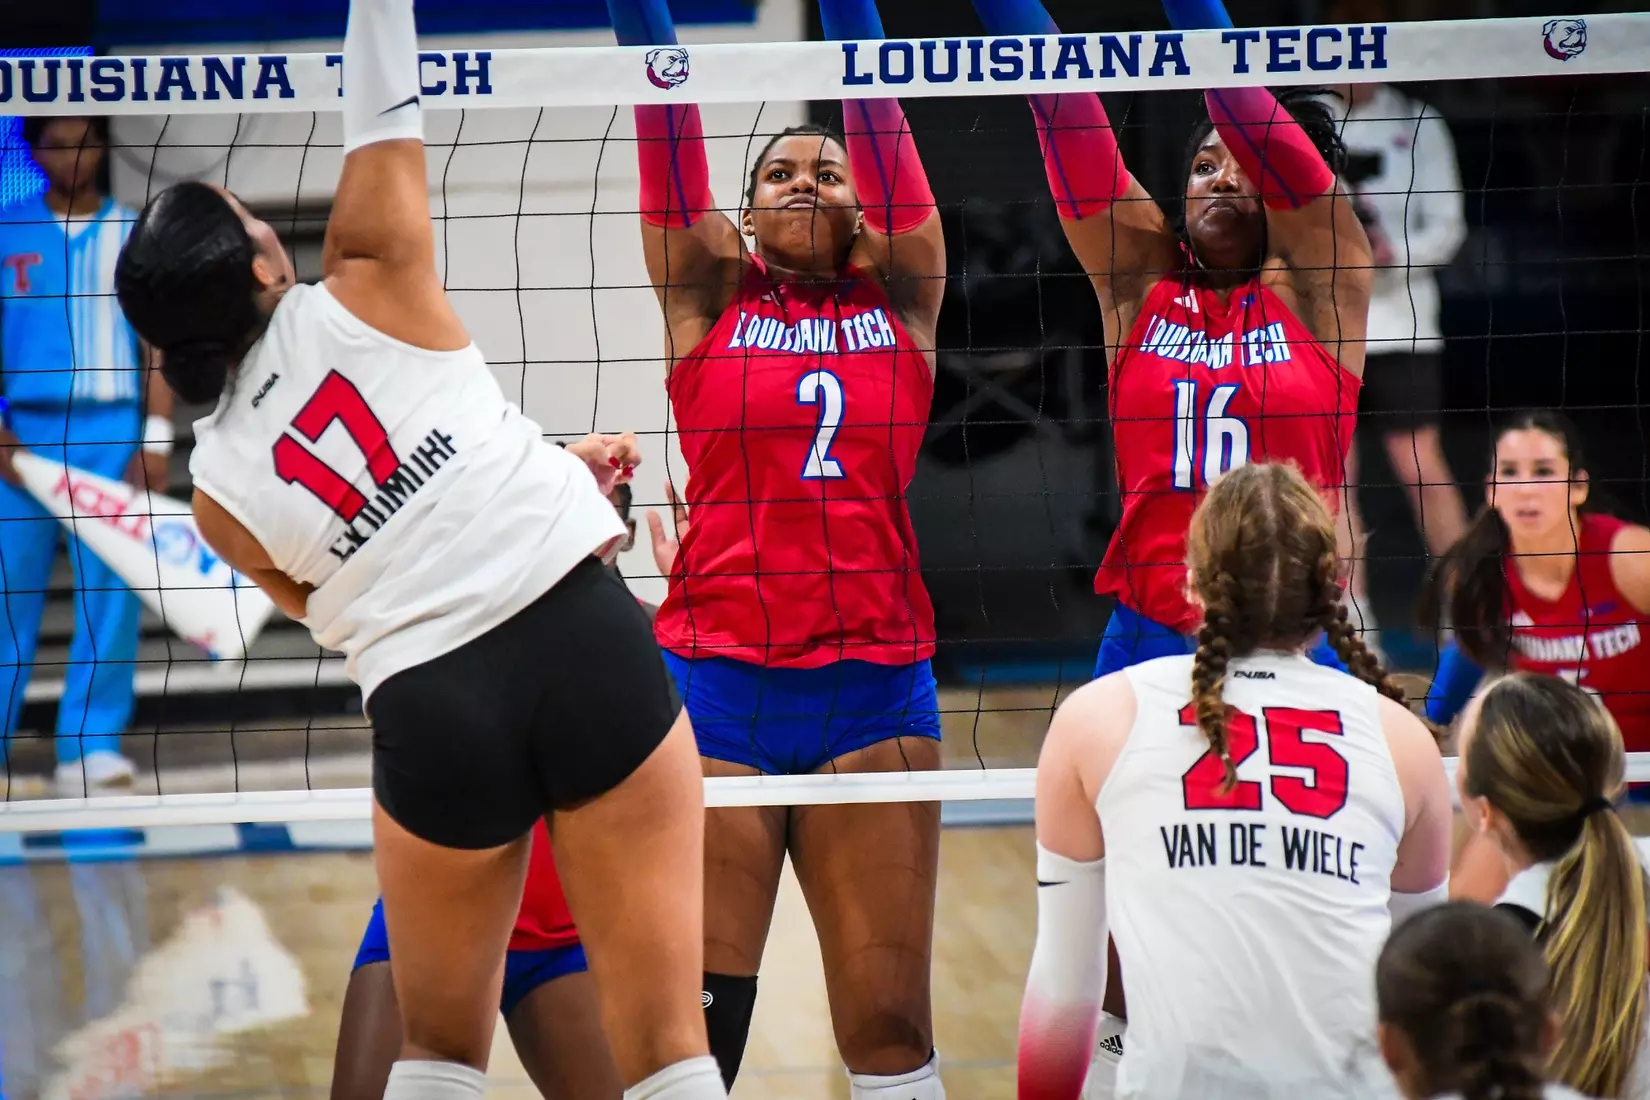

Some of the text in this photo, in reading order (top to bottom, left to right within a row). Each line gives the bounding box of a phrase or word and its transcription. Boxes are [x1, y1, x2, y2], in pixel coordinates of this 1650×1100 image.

[326, 52, 492, 97] CH
[842, 26, 1387, 85] LOUISIANA TECH
[841, 306, 896, 351] TECH
[1139, 313, 1291, 369] LOUISIANA TECH
[271, 368, 401, 525] 17
[796, 369, 846, 480] 2
[1171, 378, 1251, 492] 16
[1589, 621, 1640, 660] TECH
[1177, 699, 1349, 819] 25
[1160, 822, 1365, 885] VAN DE WIELE
[1100, 1041, 1123, 1056] adida
